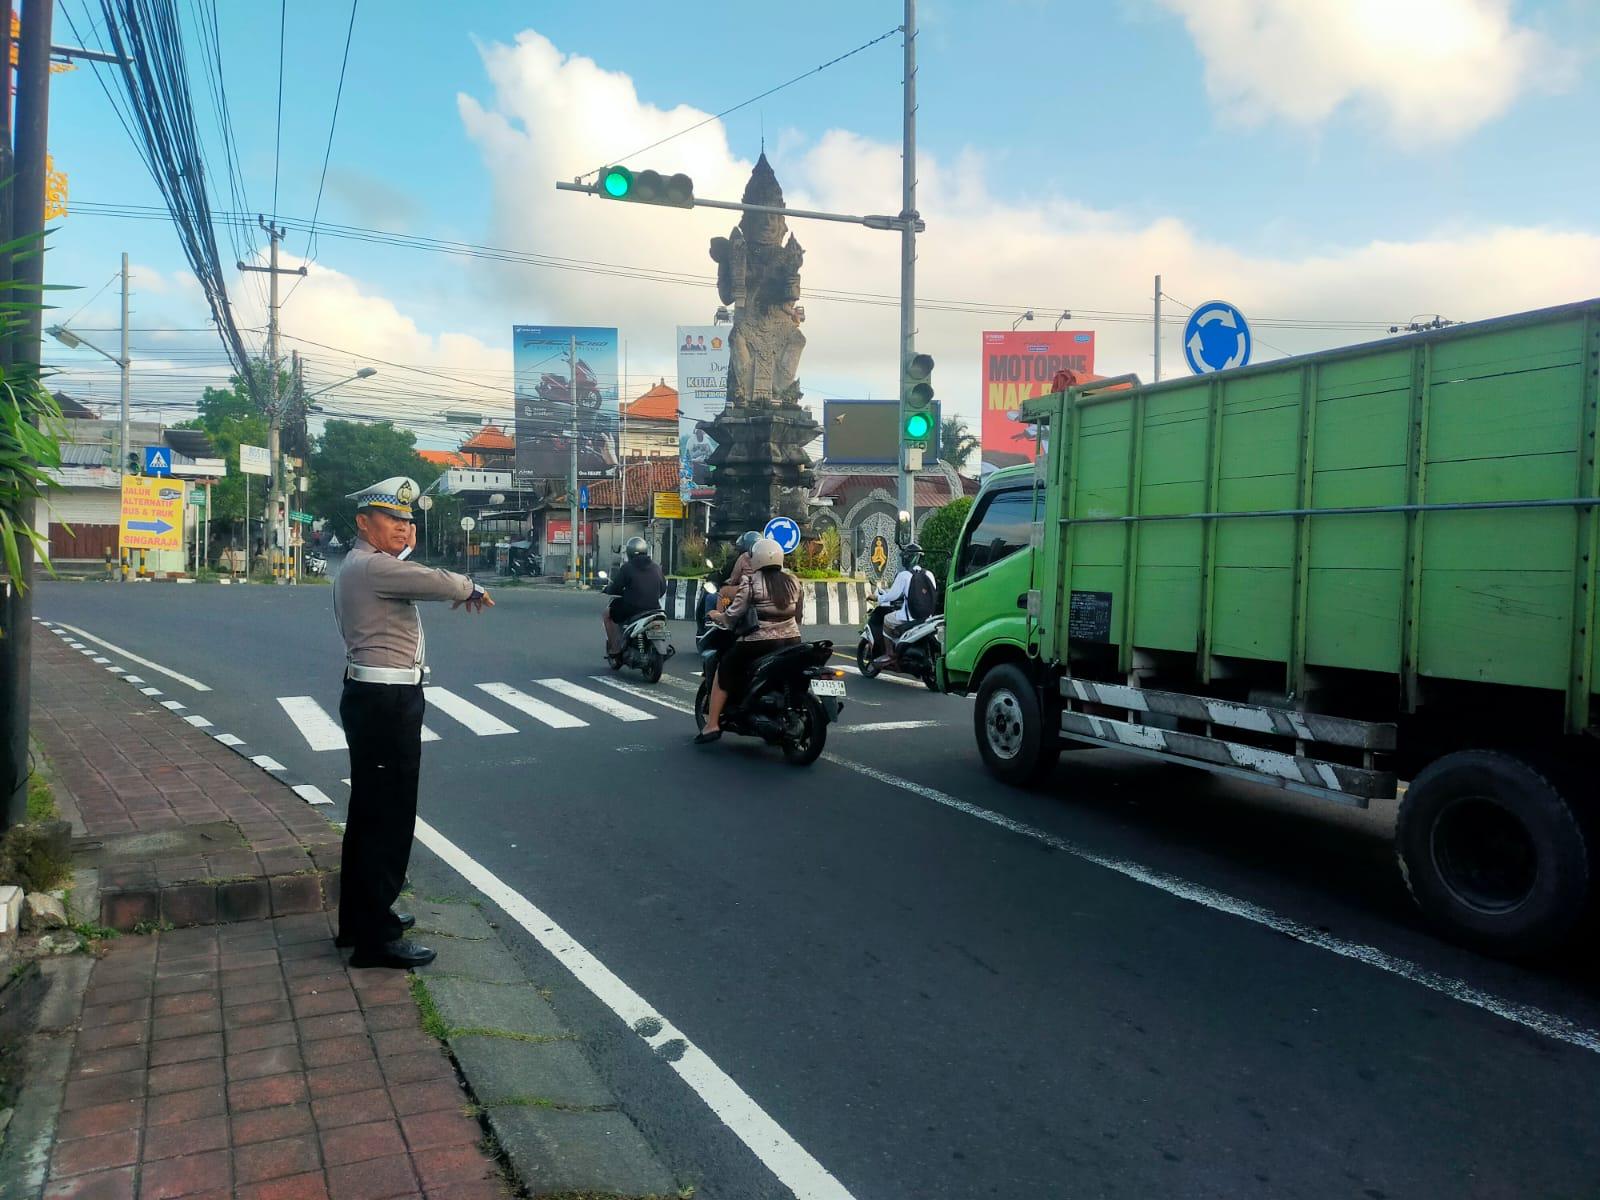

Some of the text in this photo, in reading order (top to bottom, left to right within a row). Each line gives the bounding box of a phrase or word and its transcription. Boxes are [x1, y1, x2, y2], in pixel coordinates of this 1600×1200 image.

[687, 376, 718, 388] KOTA
[123, 487, 151, 497] JALUR
[123, 497, 174, 508] ALTERNATIF
[122, 507, 174, 518] BUS & TRUK
[124, 535, 178, 547] SINGARAJA
